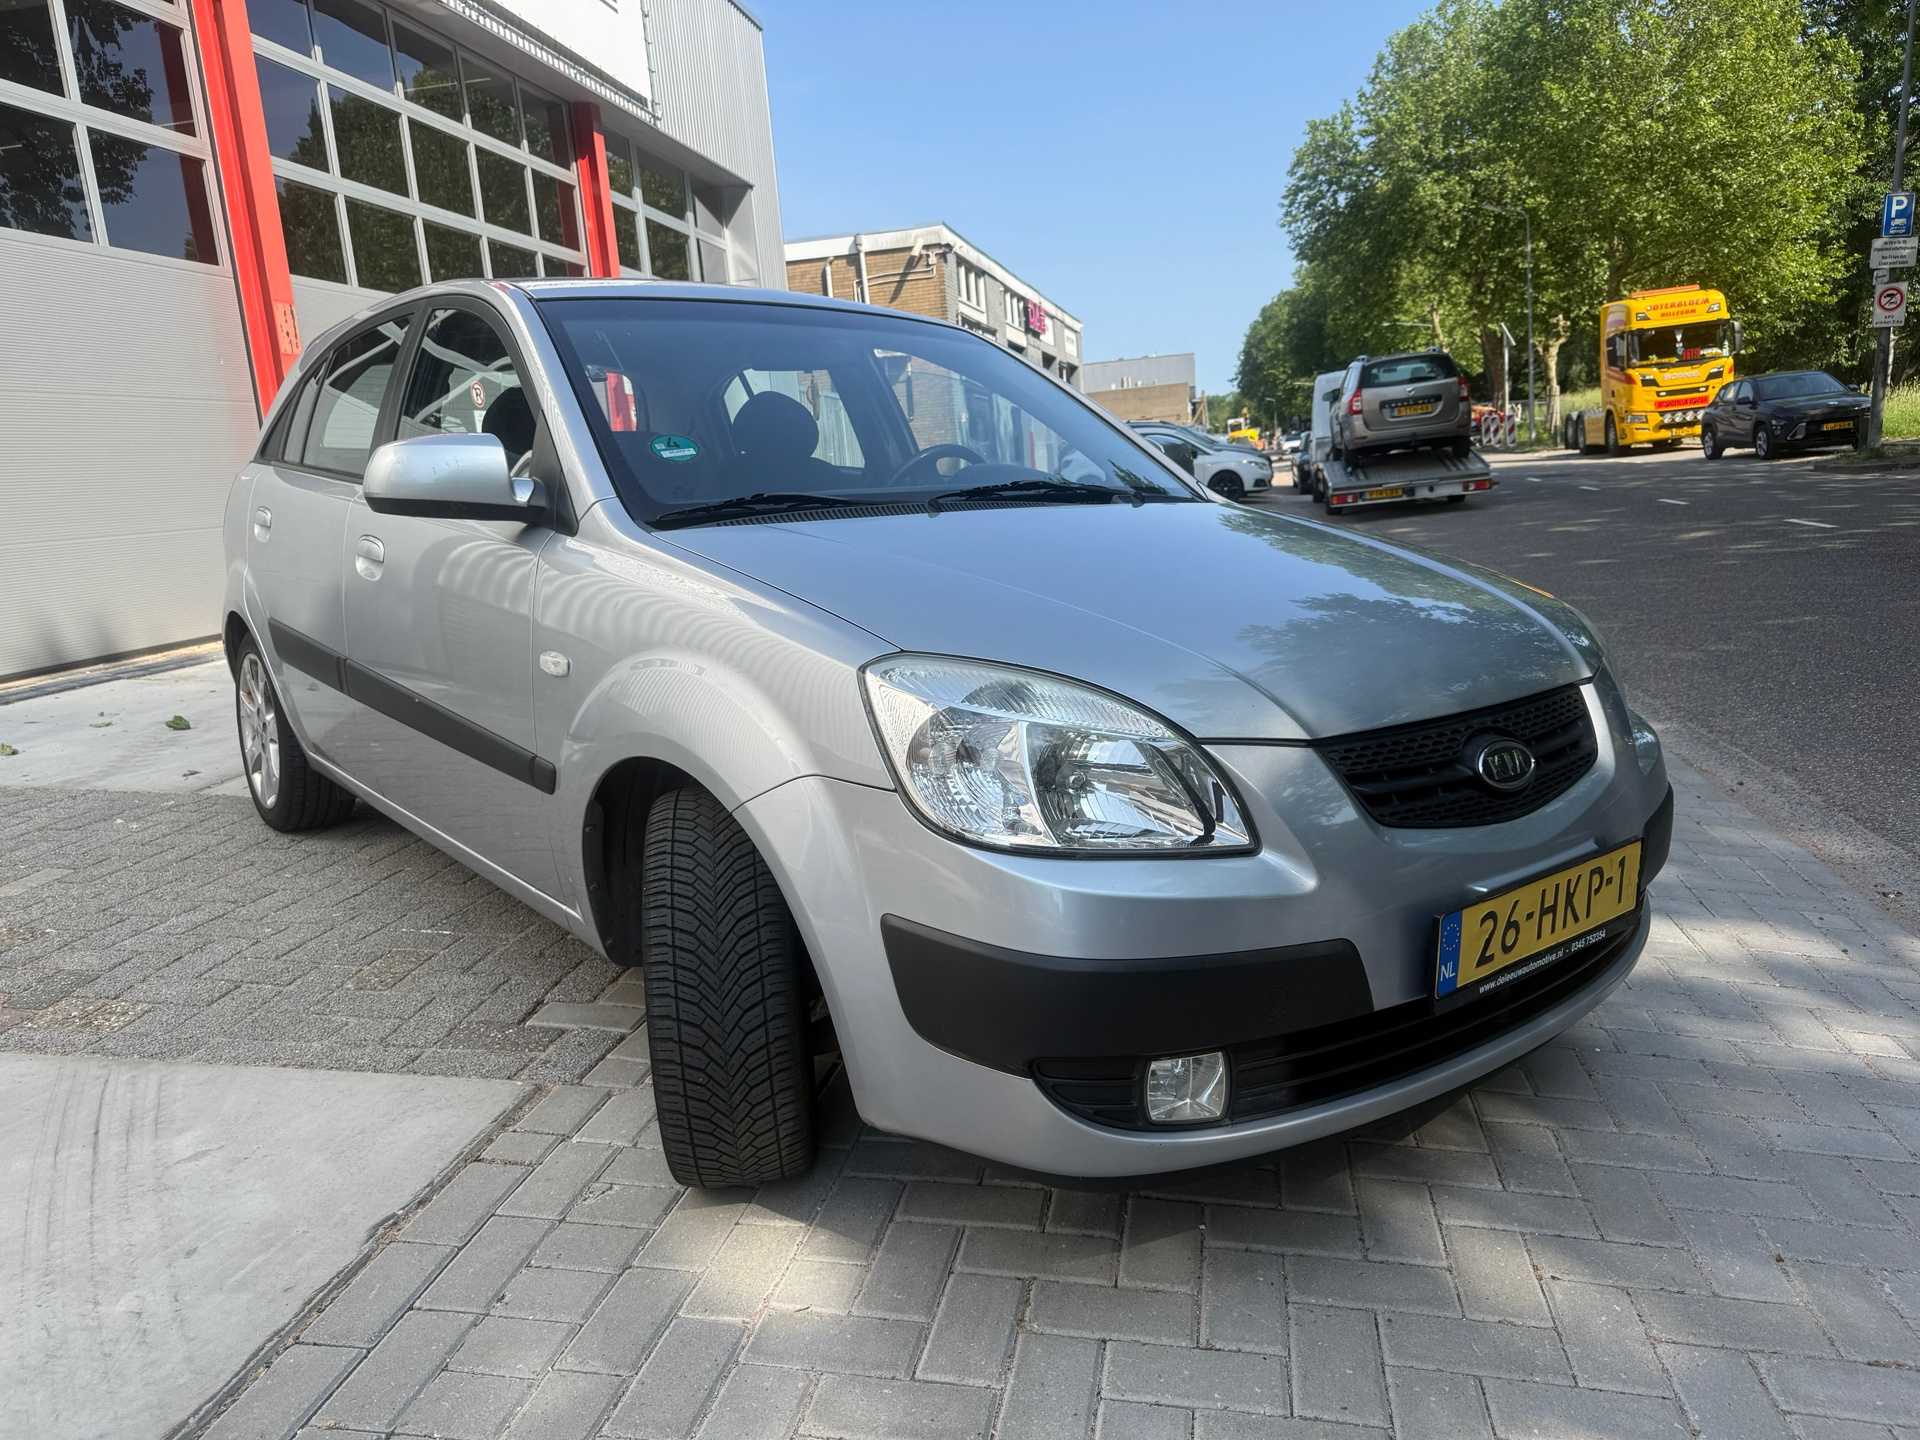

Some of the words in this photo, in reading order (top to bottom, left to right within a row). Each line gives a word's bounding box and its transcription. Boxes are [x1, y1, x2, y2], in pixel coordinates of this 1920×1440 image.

[1891, 196, 1908, 218] P
[1646, 297, 1710, 311] OTERBLOEM
[1660, 308, 1697, 318] HILLEGOM
[1663, 370, 1700, 381] SCANIA
[666, 437, 680, 448] 4
[1486, 749, 1529, 780] KIA
[1475, 855, 1626, 969] 26-HKP-1
[1440, 961, 1456, 982] NL
[1479, 947, 1564, 994] www.deleeuwautomotive.nl
[1570, 940, 1585, 952] 0345
